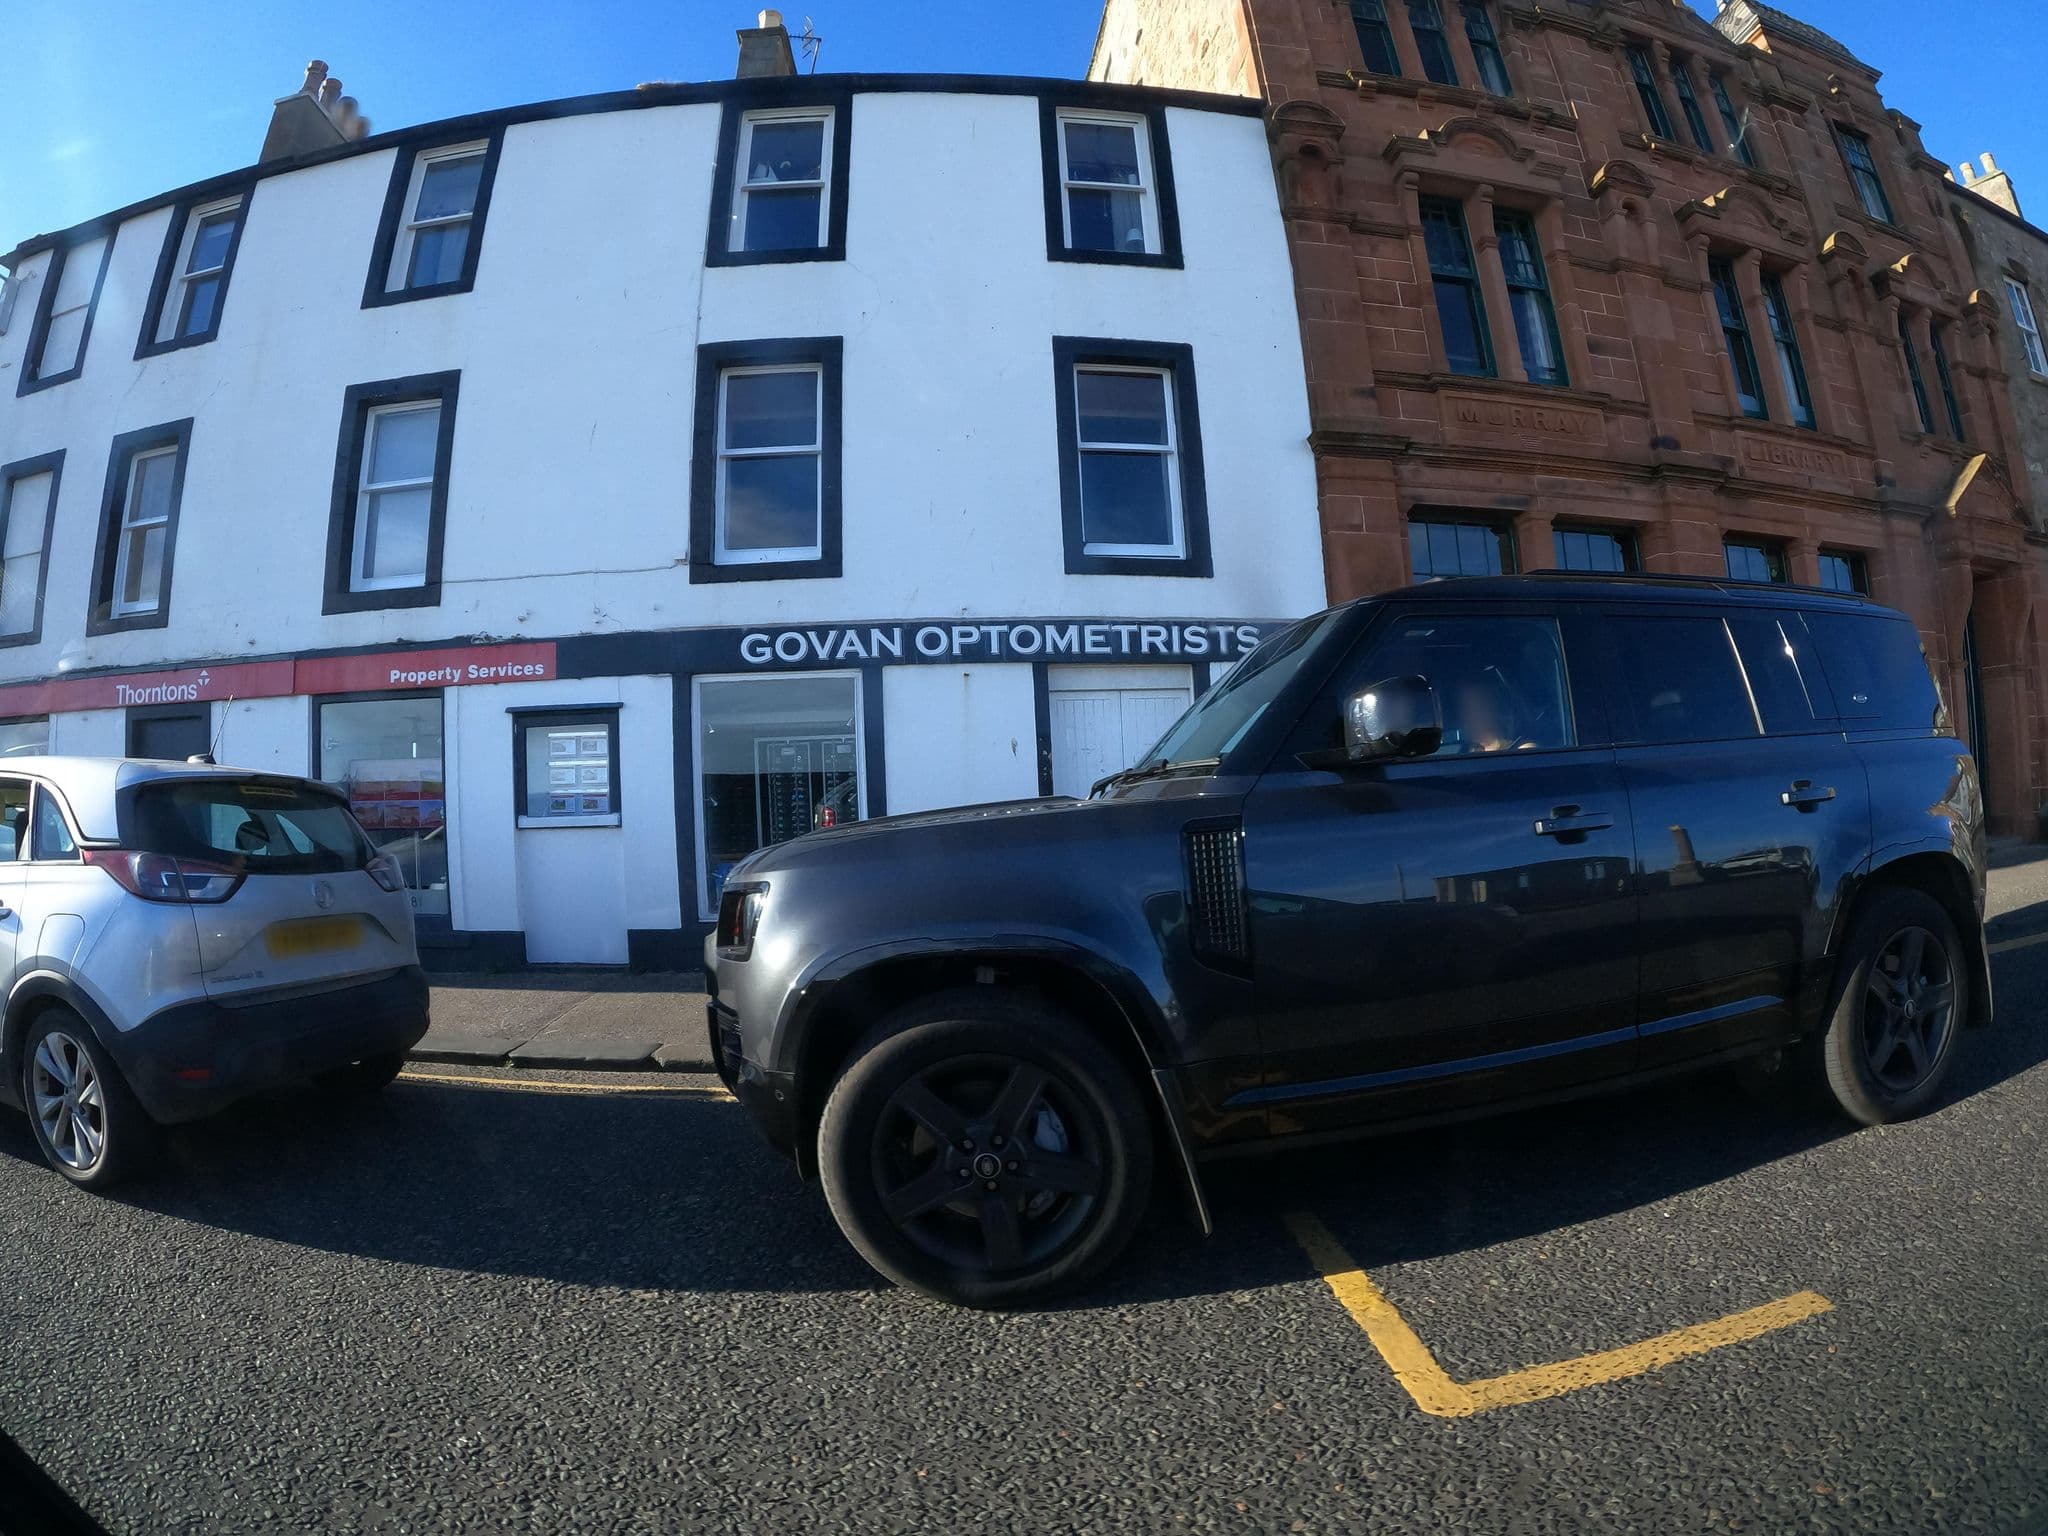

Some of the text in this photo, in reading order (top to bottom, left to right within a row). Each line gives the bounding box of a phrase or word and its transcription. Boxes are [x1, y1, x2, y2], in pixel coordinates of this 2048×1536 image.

[1456, 400, 1587, 434] MURRAY
[1747, 440, 1840, 473] LIBRARY
[740, 622, 1260, 664] GOVAN OPTOMETRISTS
[389, 662, 545, 684] Property Services
[115, 682, 198, 705] Thorntons
